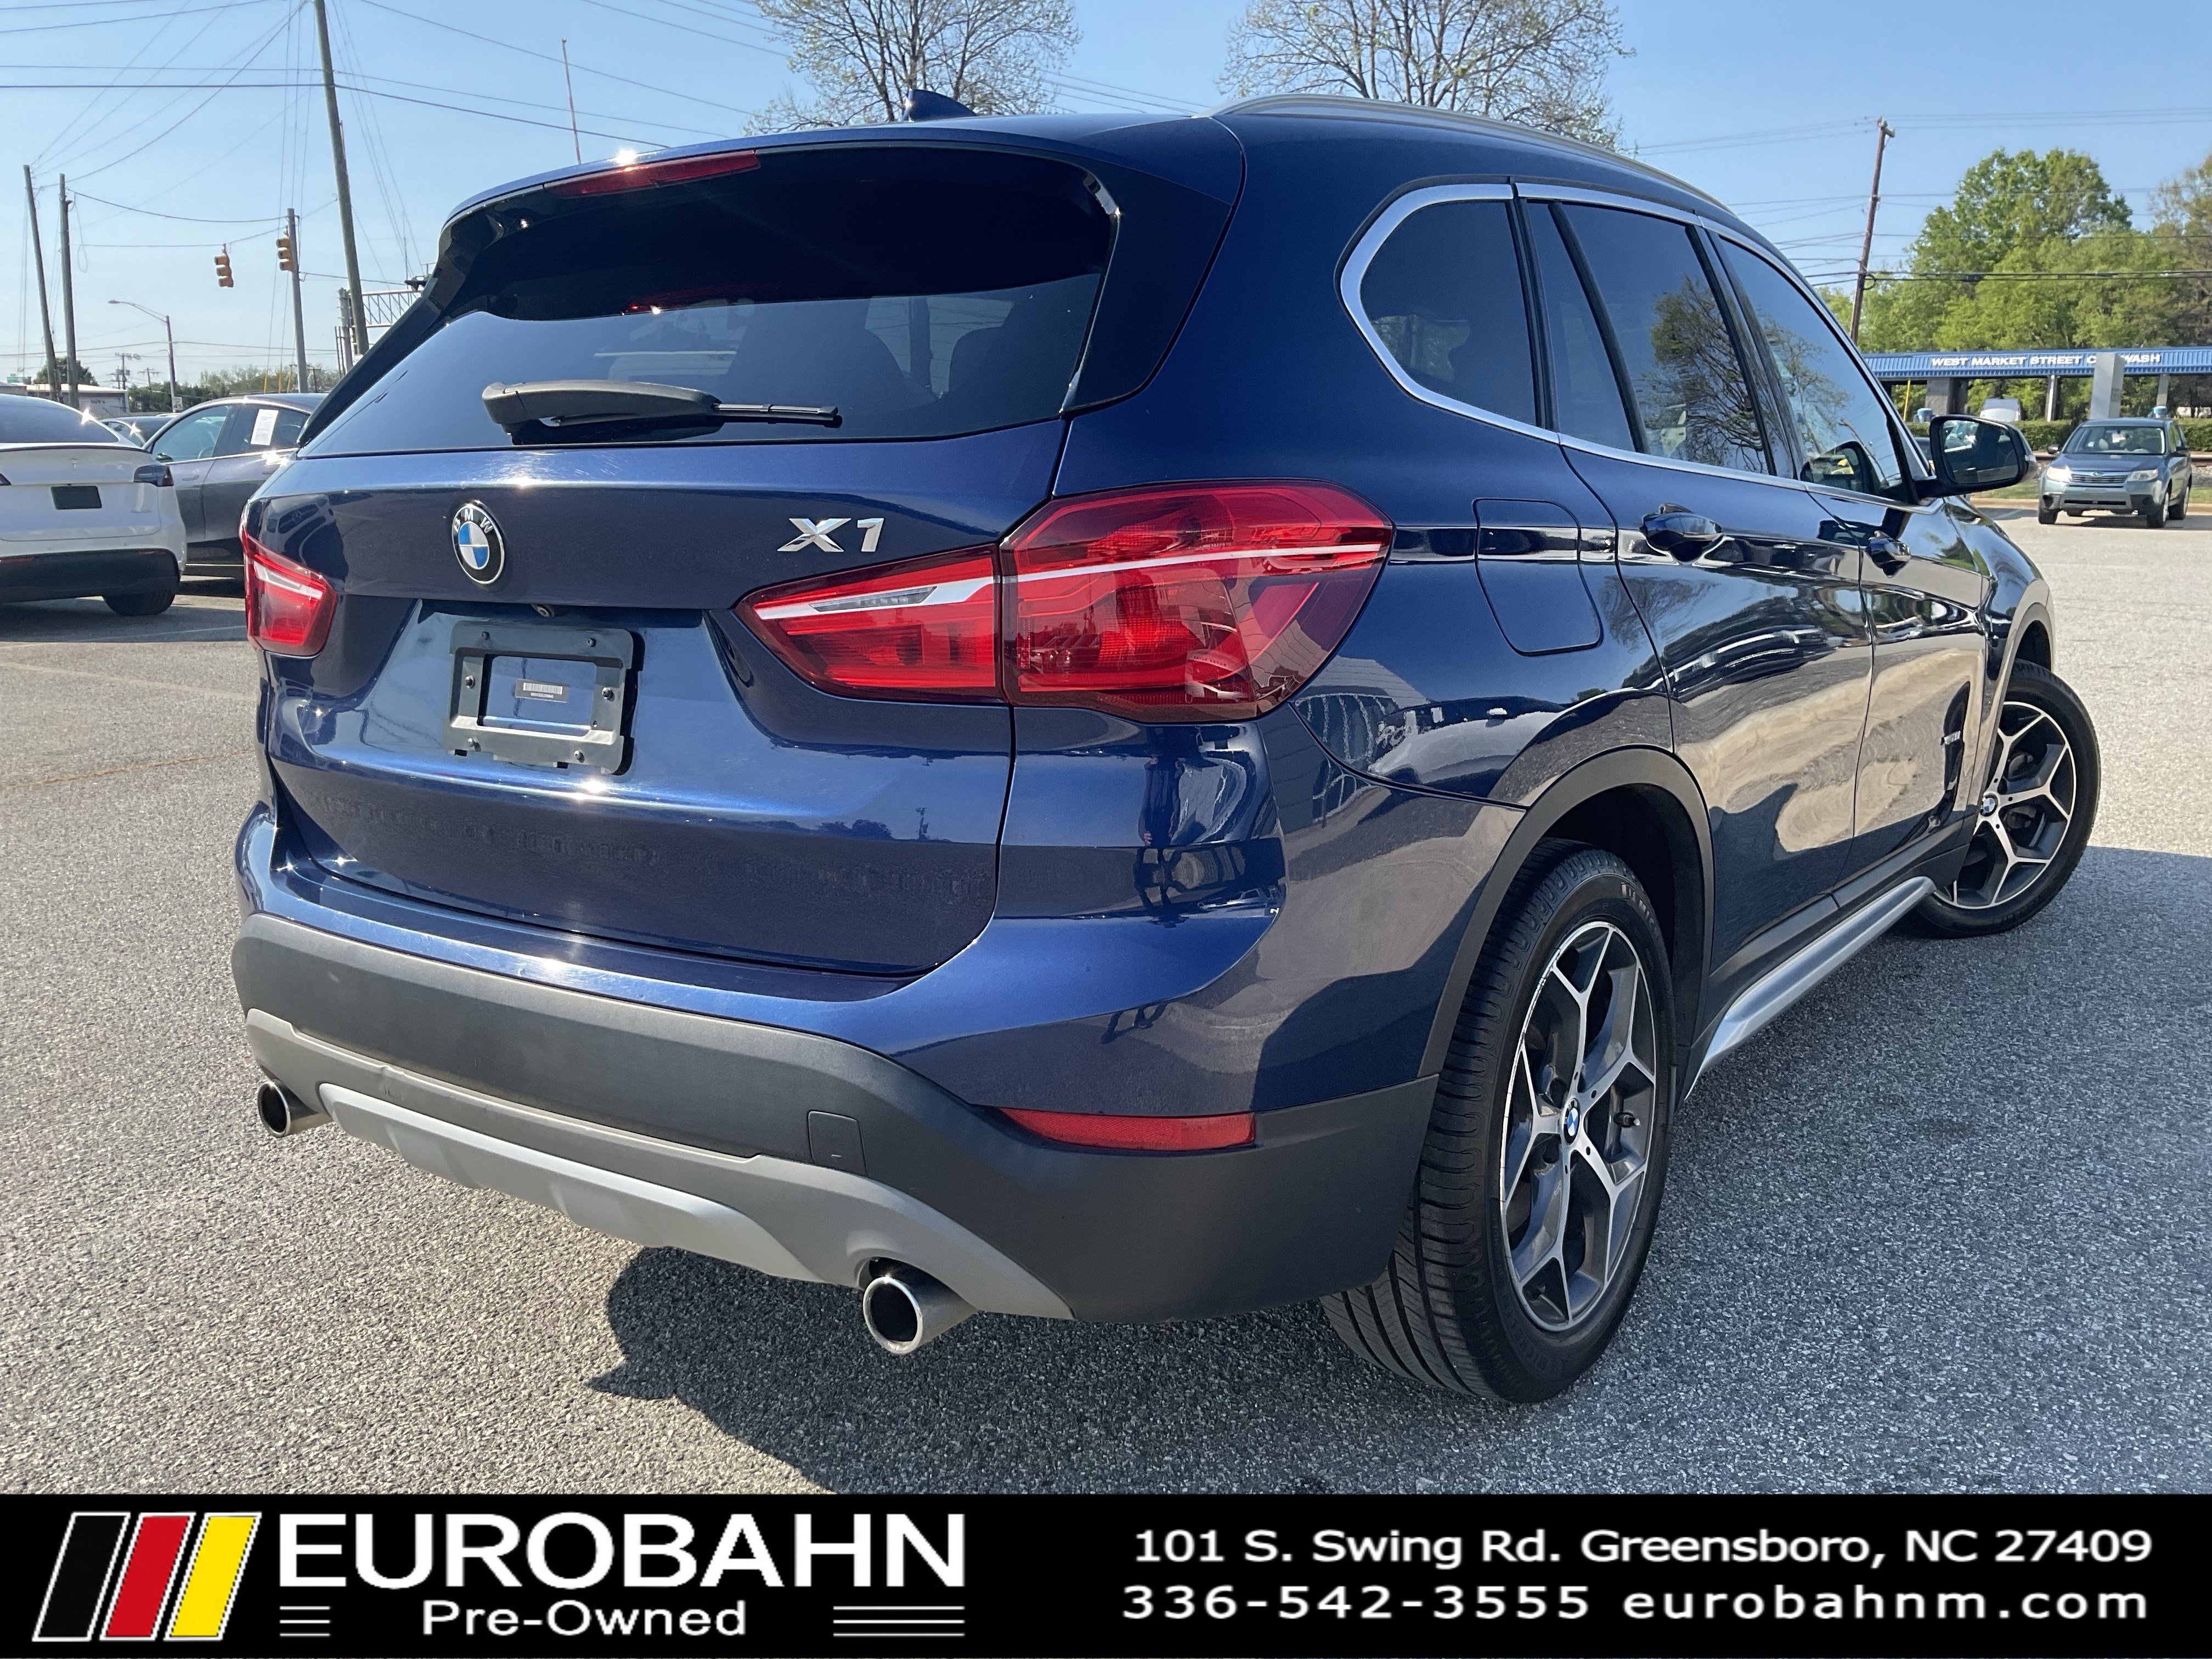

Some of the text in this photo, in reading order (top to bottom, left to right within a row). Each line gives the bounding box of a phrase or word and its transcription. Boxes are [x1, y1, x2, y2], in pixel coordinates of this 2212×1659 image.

[1932, 358, 1968, 366] WEST
[1971, 357, 2026, 365] MARKET
[2029, 356, 2082, 365] STREET
[453, 508, 494, 534] BMW
[777, 517, 884, 552] X1
